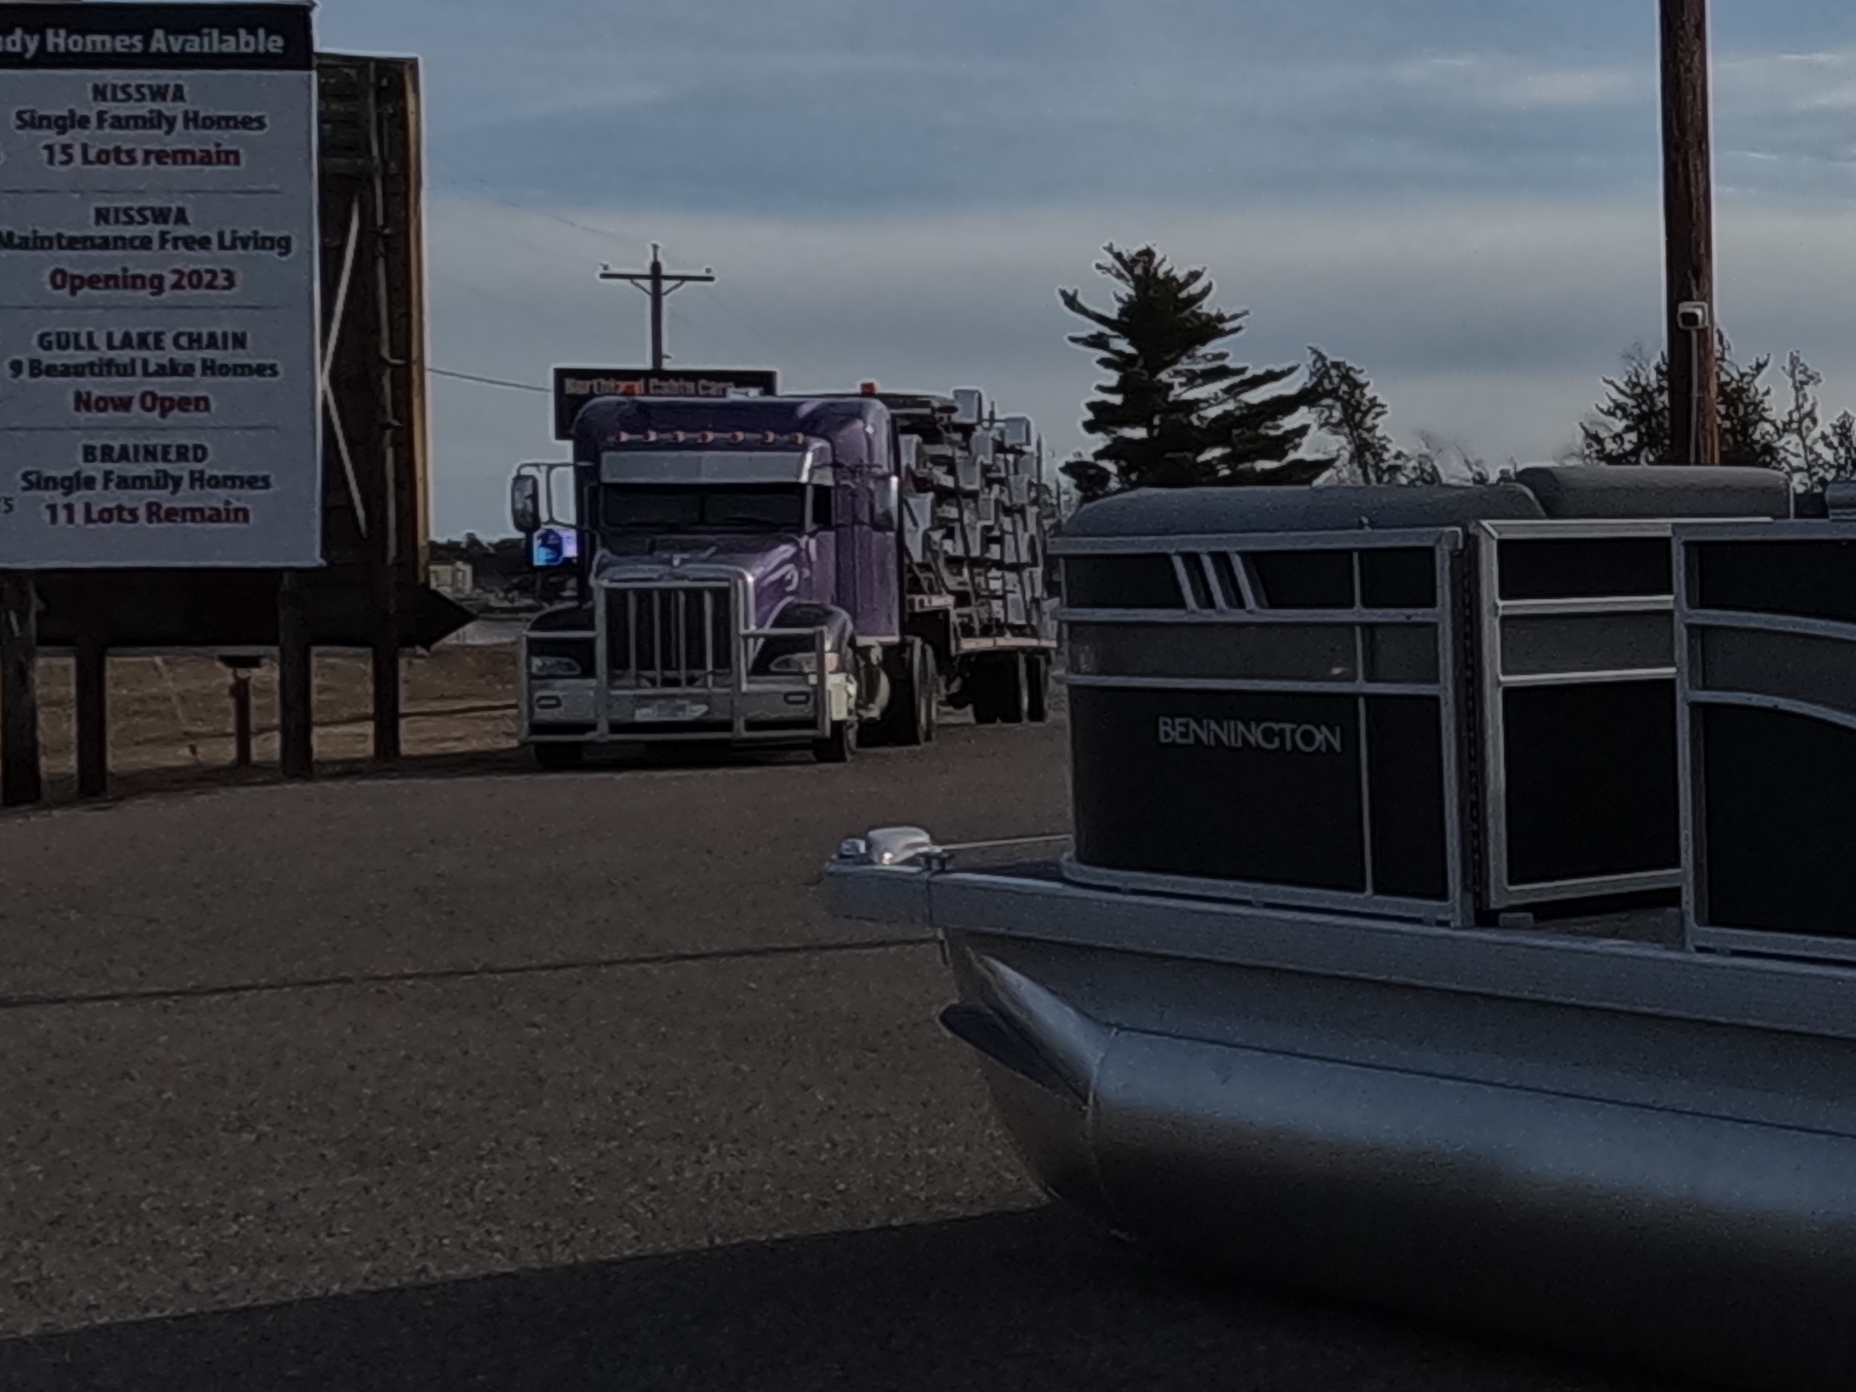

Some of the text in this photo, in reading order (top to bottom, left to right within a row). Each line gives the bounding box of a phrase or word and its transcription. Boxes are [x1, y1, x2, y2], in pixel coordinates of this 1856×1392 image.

[45, 28, 144, 54] Homes
[149, 26, 285, 55] Available
[91, 82, 187, 103] NISSWA
[14, 108, 267, 135] Single Family Homes
[42, 142, 241, 166] 15 Lots remain
[94, 205, 190, 226] NISSWA
[158, 229, 213, 251] Free
[216, 229, 293, 257] Living
[49, 266, 237, 297] Opening 2023
[37, 330, 249, 352] GULL LAKE CHAIN
[8, 358, 280, 379] 9 Beautiful Lake Homes
[73, 390, 212, 419] Now Open
[81, 443, 209, 464] BRAINERD
[20, 469, 272, 497] Single Family Homes
[44, 500, 250, 525] 11 Lots Remain
[1157, 714, 1343, 754] BENNINGTON
